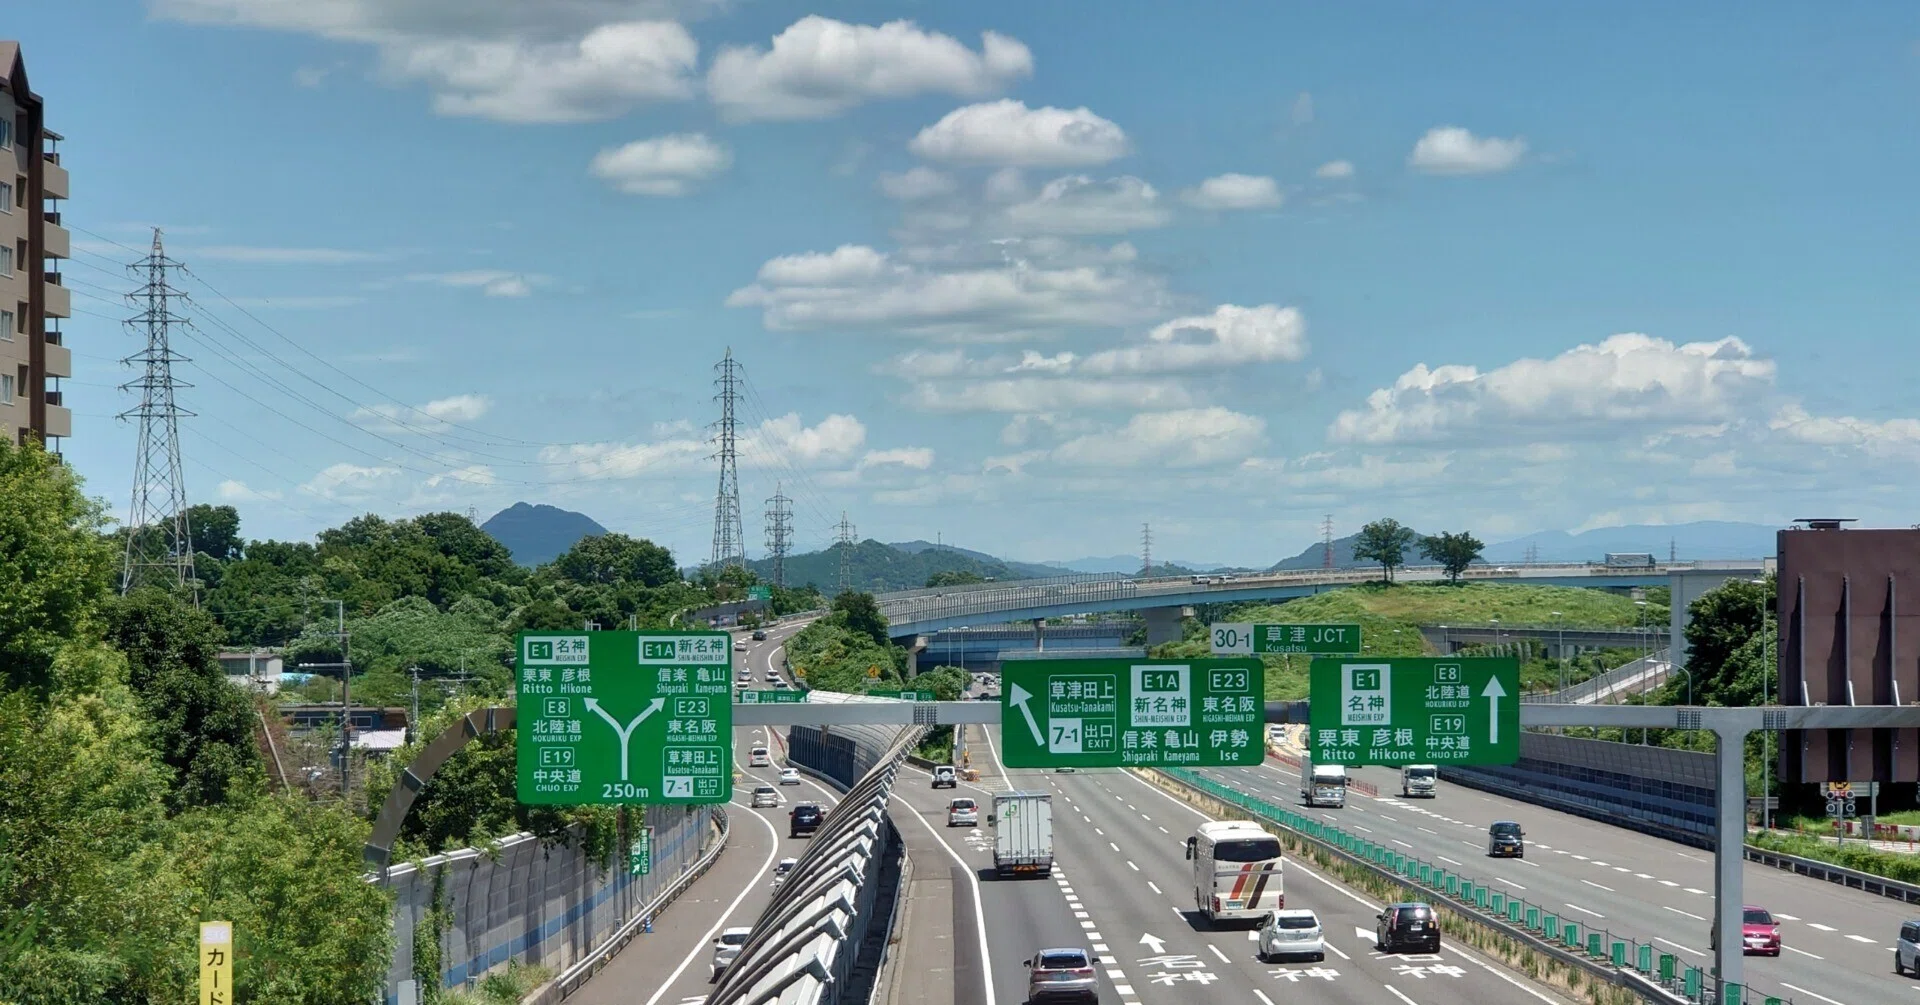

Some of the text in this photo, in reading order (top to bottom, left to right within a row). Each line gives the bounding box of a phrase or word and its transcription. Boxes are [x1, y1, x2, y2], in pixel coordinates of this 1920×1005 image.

[1215, 629, 1250, 648] 30-1
[1266, 626, 1349, 644] 草津 JCT.
[531, 644, 549, 657] E1
[556, 639, 586, 653] 名神
[645, 644, 674, 656] E1A
[678, 639, 724, 653] 新名神
[1265, 644, 1307, 652] Kusatsu
[523, 668, 591, 682] 栗東 彦根
[657, 668, 726, 682] 信楽 亀山
[1213, 673, 1245, 688] E23
[1356, 673, 1375, 687] E1
[1439, 667, 1457, 680] E8
[1144, 674, 1178, 688] E1A
[523, 683, 592, 694] Ritto Hikone
[656, 683, 727, 695] Shigaraki Kameyama
[1050, 681, 1114, 700] 草津田上
[1425, 685, 1470, 699] 北陸道
[548, 701, 566, 714] E8
[678, 701, 706, 713] E23
[1051, 701, 1114, 713] Kusatsu-Tanakami
[1134, 696, 1187, 713] 新名神
[1202, 696, 1255, 713] 東名阪
[1347, 695, 1385, 711] 名神
[1134, 715, 1187, 723] SHIN-MEISHIN EXP
[1202, 715, 1255, 723] HIGASHI-MEIHAN EXP
[1434, 718, 1462, 731] E19
[532, 720, 582, 734] 北陸道
[667, 719, 717, 734] 東名阪
[1084, 724, 1113, 738] 出口
[1053, 726, 1078, 745] 7-1
[1122, 729, 1249, 749] 信楽 亀山 伊勢
[1318, 728, 1414, 747] 栗東 彦根
[1425, 735, 1470, 750] 中央道
[1088, 739, 1110, 748] EXIT
[543, 751, 572, 763] E19
[668, 750, 718, 765] 草津田上
[1122, 750, 1239, 764] Shigaraki Kameyama Ise
[1322, 748, 1416, 760] Ritto Hikone
[1426, 751, 1469, 759] CHUO EXP
[533, 769, 582, 783] 中央道
[667, 765, 719, 775] Kusatsu-Tanakami
[536, 784, 579, 792] CHUO EXP
[602, 784, 649, 798] 250m
[665, 780, 690, 794] 7-1
[698, 779, 718, 789] 出口
